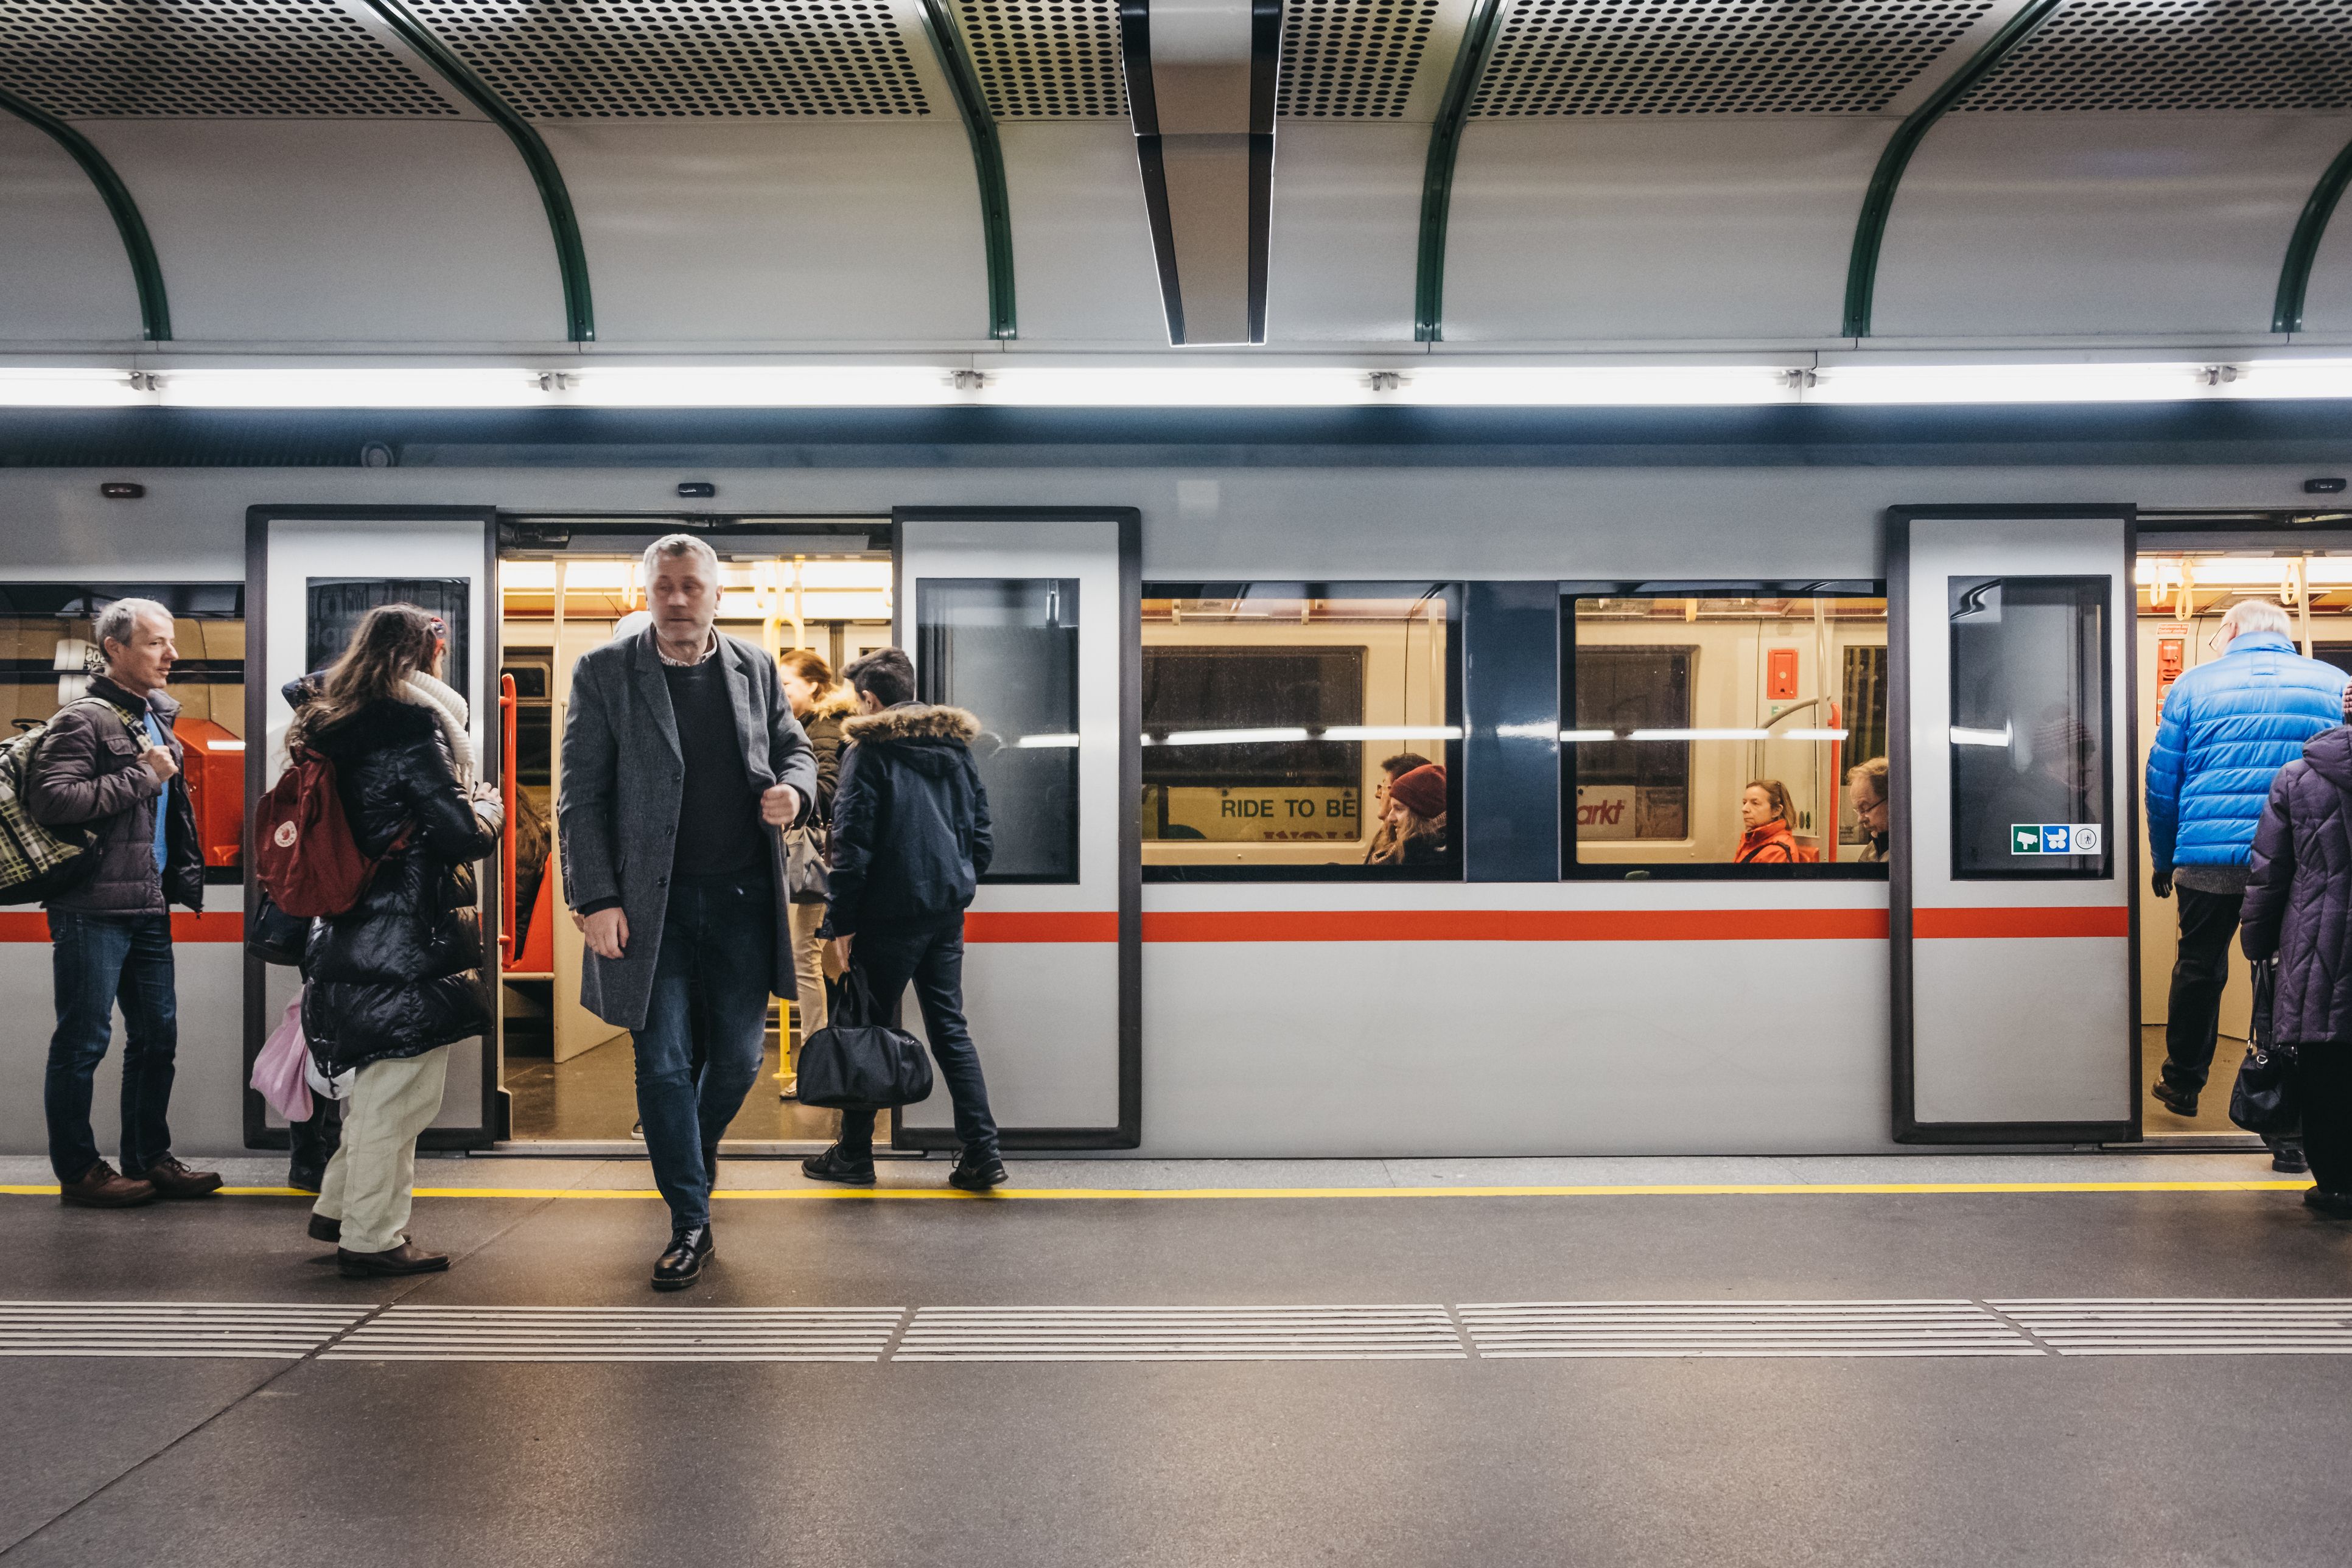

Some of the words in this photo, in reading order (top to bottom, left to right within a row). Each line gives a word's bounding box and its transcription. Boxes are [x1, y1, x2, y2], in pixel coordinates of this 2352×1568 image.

[1221, 799, 1274, 817] RIDE
[1284, 799, 1315, 817] TO
[1326, 799, 1356, 817] BE
